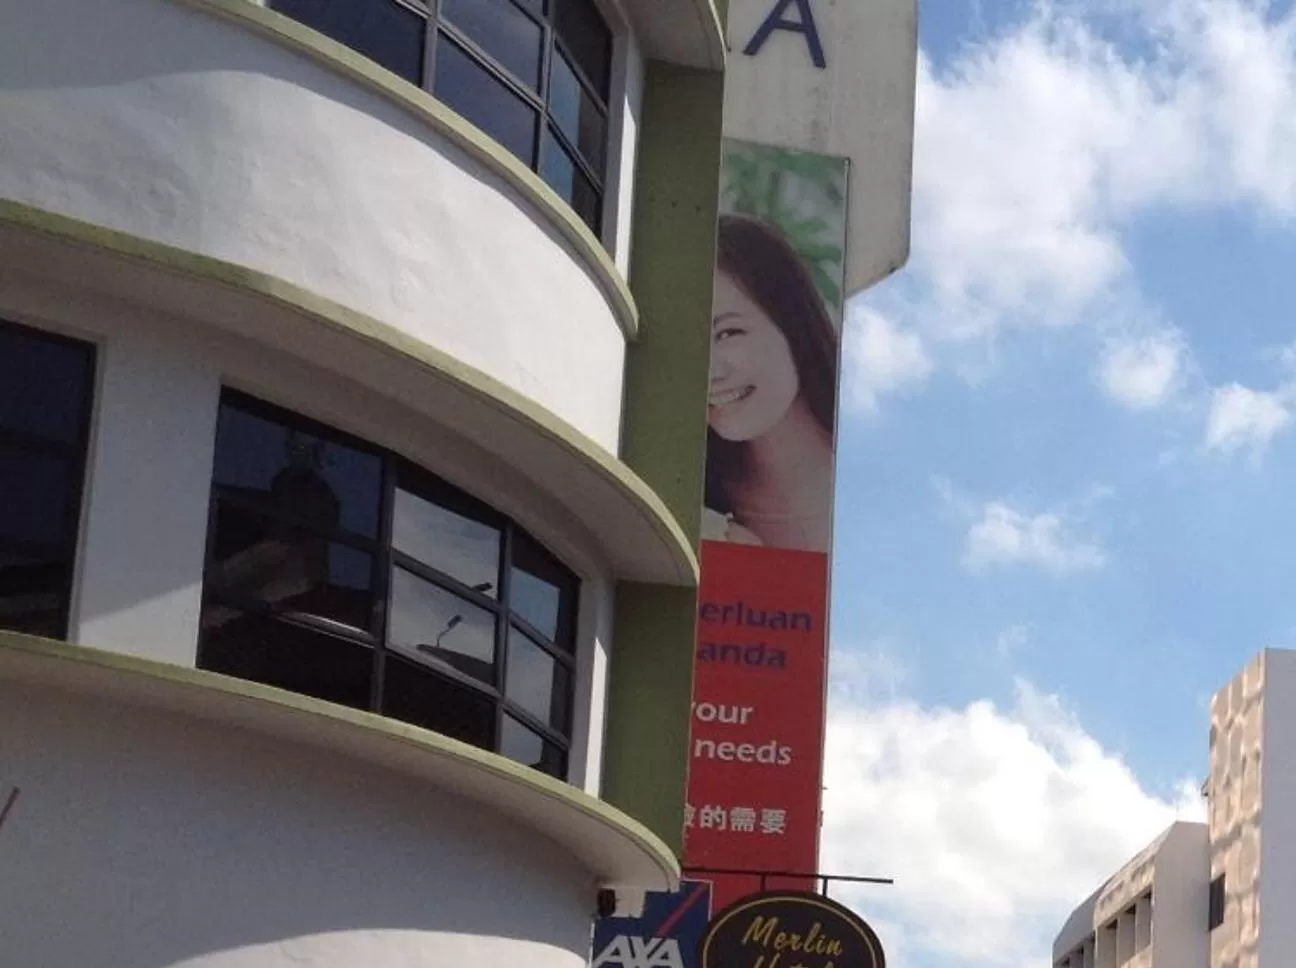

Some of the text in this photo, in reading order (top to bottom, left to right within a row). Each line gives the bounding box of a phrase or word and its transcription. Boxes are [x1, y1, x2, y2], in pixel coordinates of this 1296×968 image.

[742, 0, 827, 69] A
[696, 640, 787, 669] anda
[691, 701, 753, 726] our
[694, 738, 792, 766] needs
[741, 915, 844, 957] Merlin
